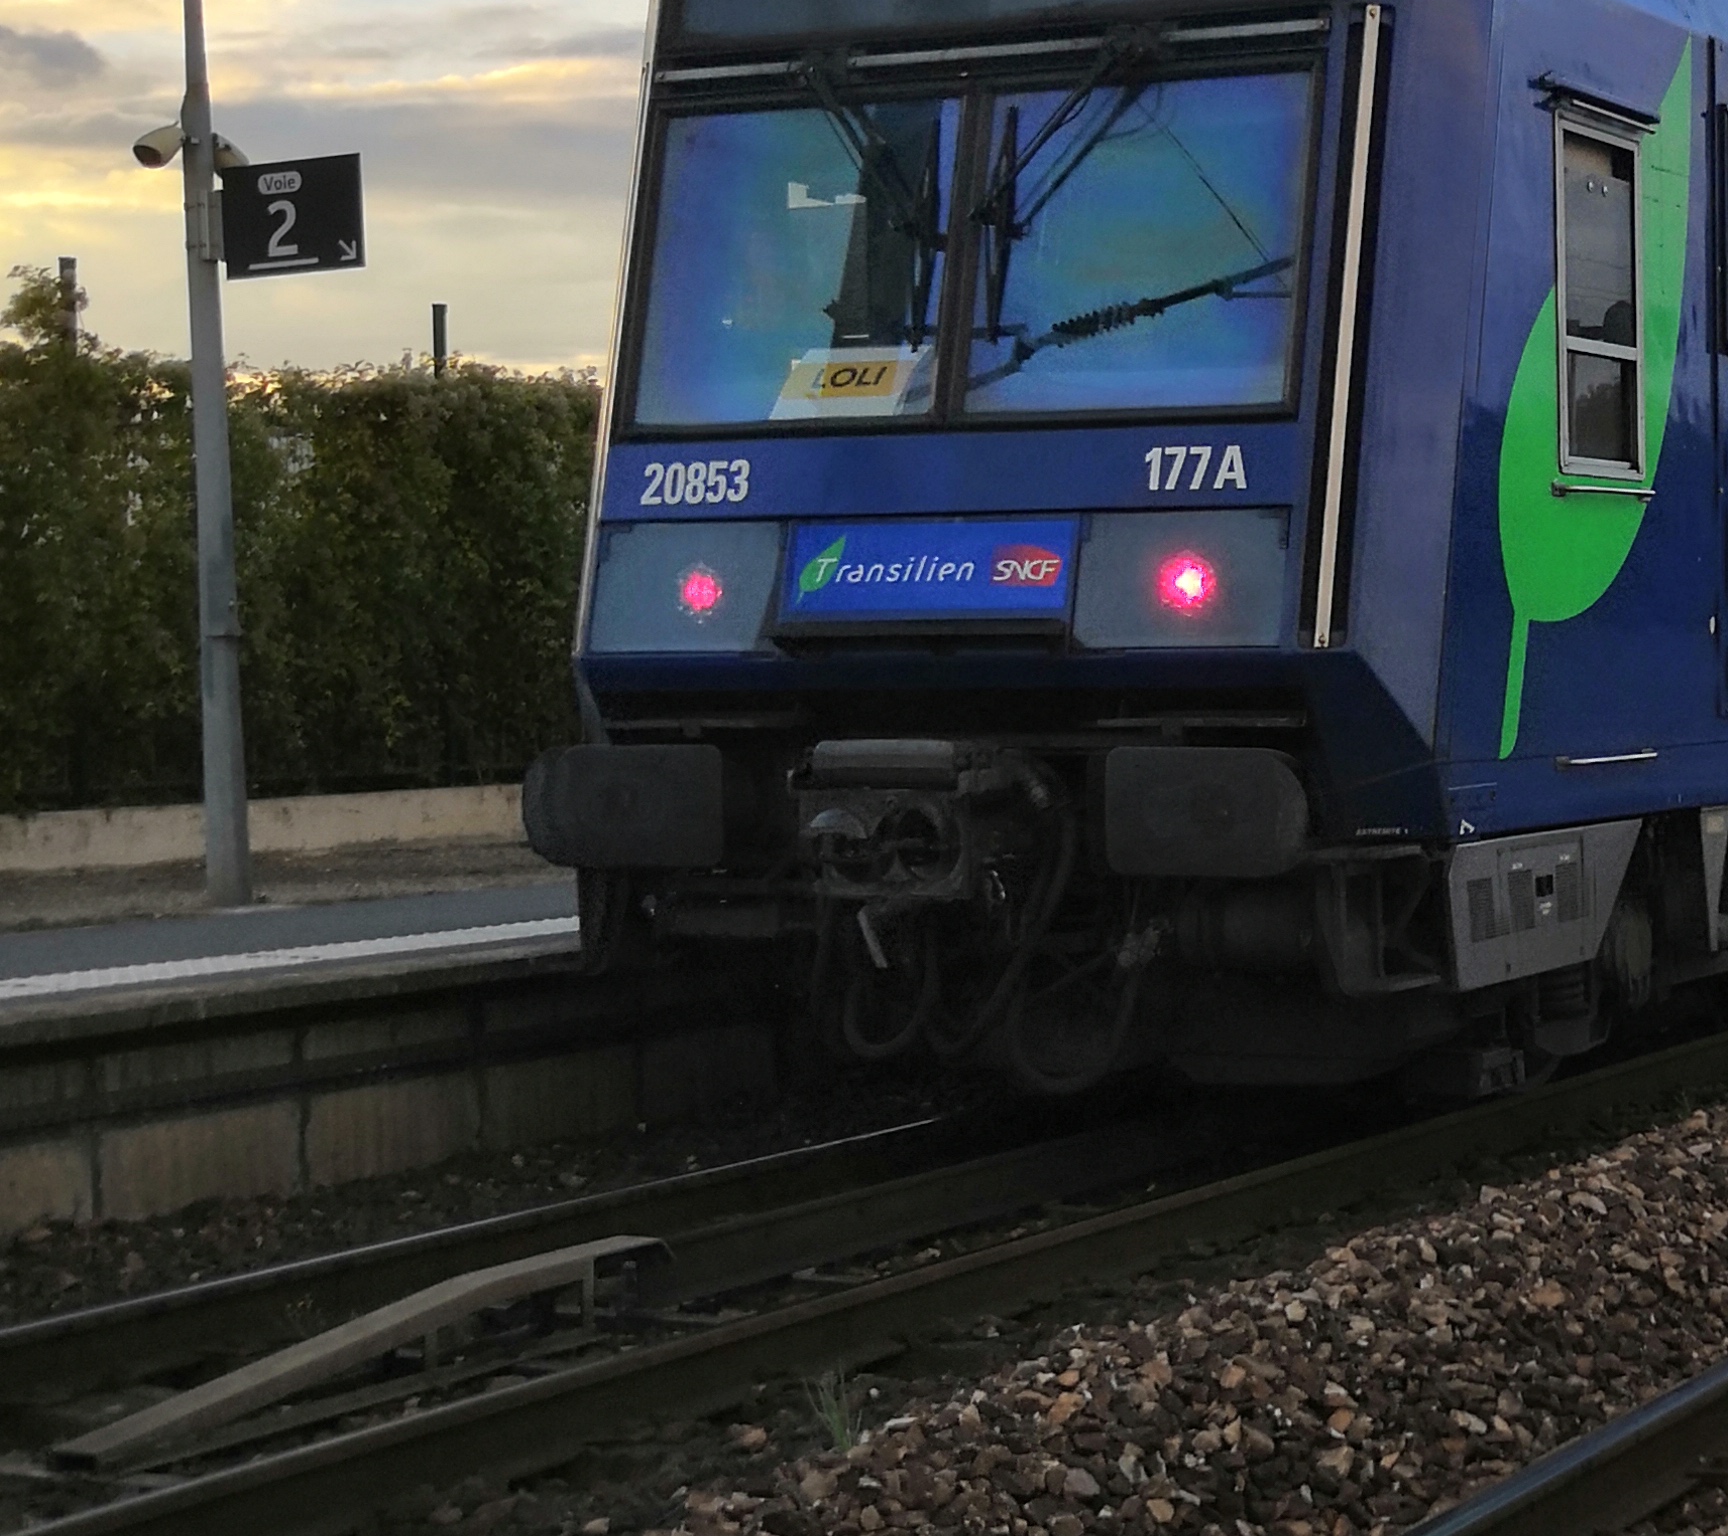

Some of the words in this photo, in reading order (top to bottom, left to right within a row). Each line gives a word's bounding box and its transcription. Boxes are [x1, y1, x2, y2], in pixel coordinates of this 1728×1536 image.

[264, 174, 296, 191] Voie
[267, 200, 298, 257] 2
[640, 460, 750, 506] 20853
[1144, 445, 1247, 491] 177A
[816, 555, 975, 582] Transilien
[993, 559, 1060, 581] SNCF
